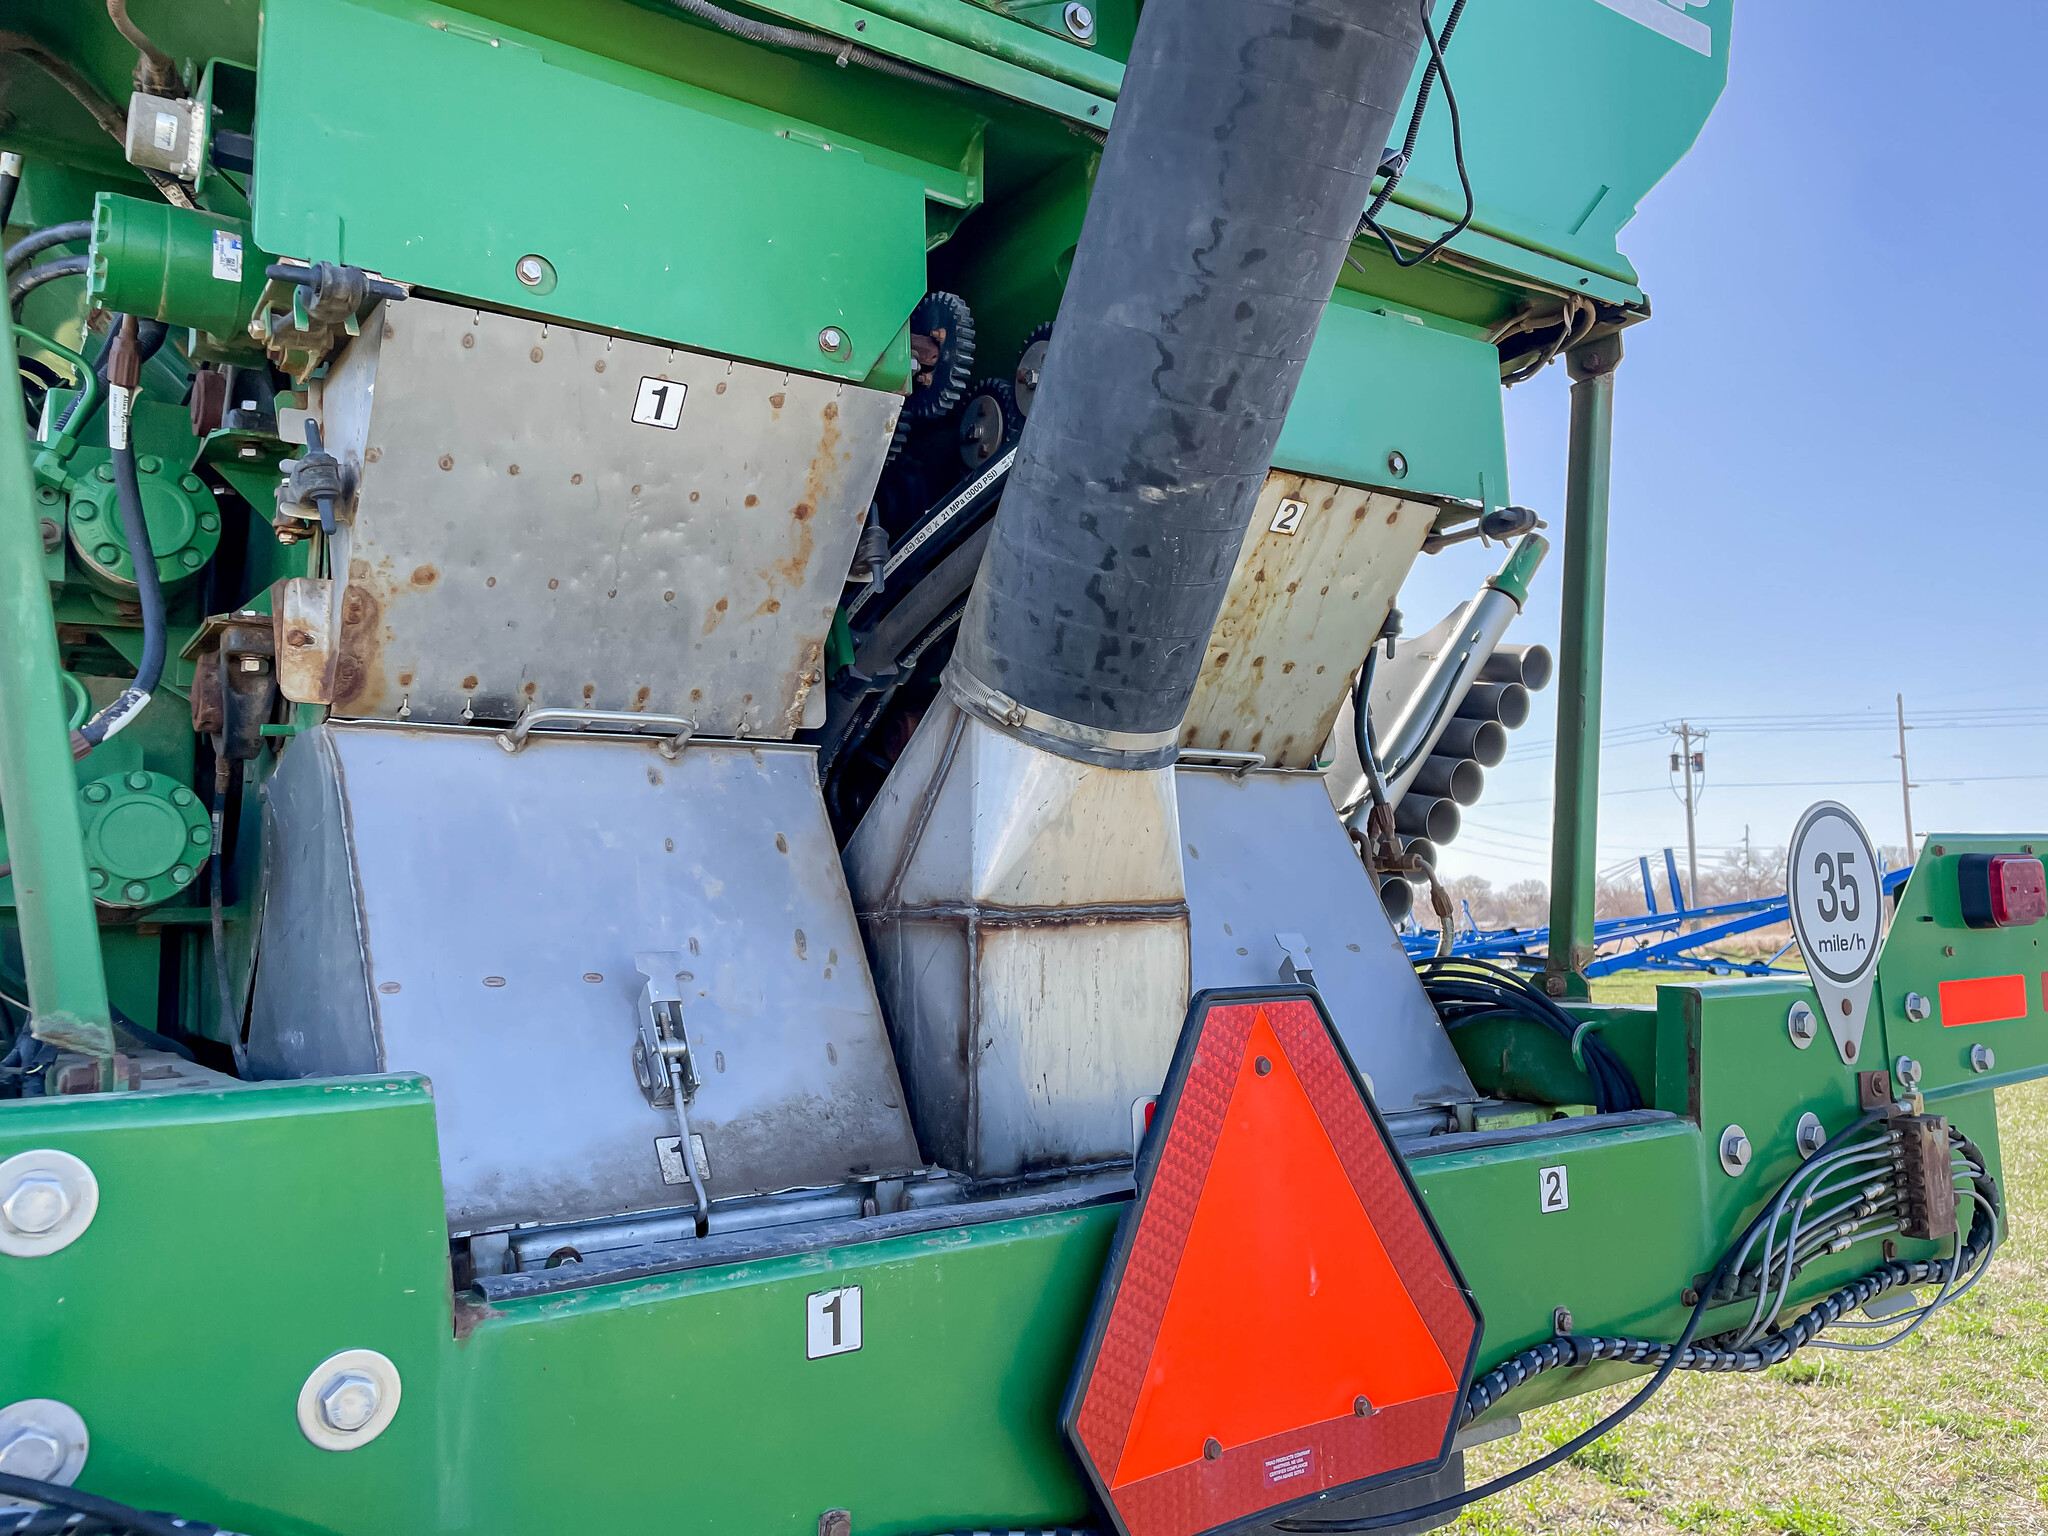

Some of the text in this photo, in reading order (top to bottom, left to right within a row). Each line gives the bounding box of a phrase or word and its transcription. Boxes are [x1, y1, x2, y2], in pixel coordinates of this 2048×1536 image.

[652, 386, 669, 420] 1
[941, 469, 998, 520] 21 MPa (3000 PSI)
[1277, 504, 1298, 530] 2
[1815, 852, 1860, 922] 35
[1819, 933, 1866, 952] mile/h
[1547, 1171, 1562, 1206] 2
[823, 1296, 841, 1346] 1
